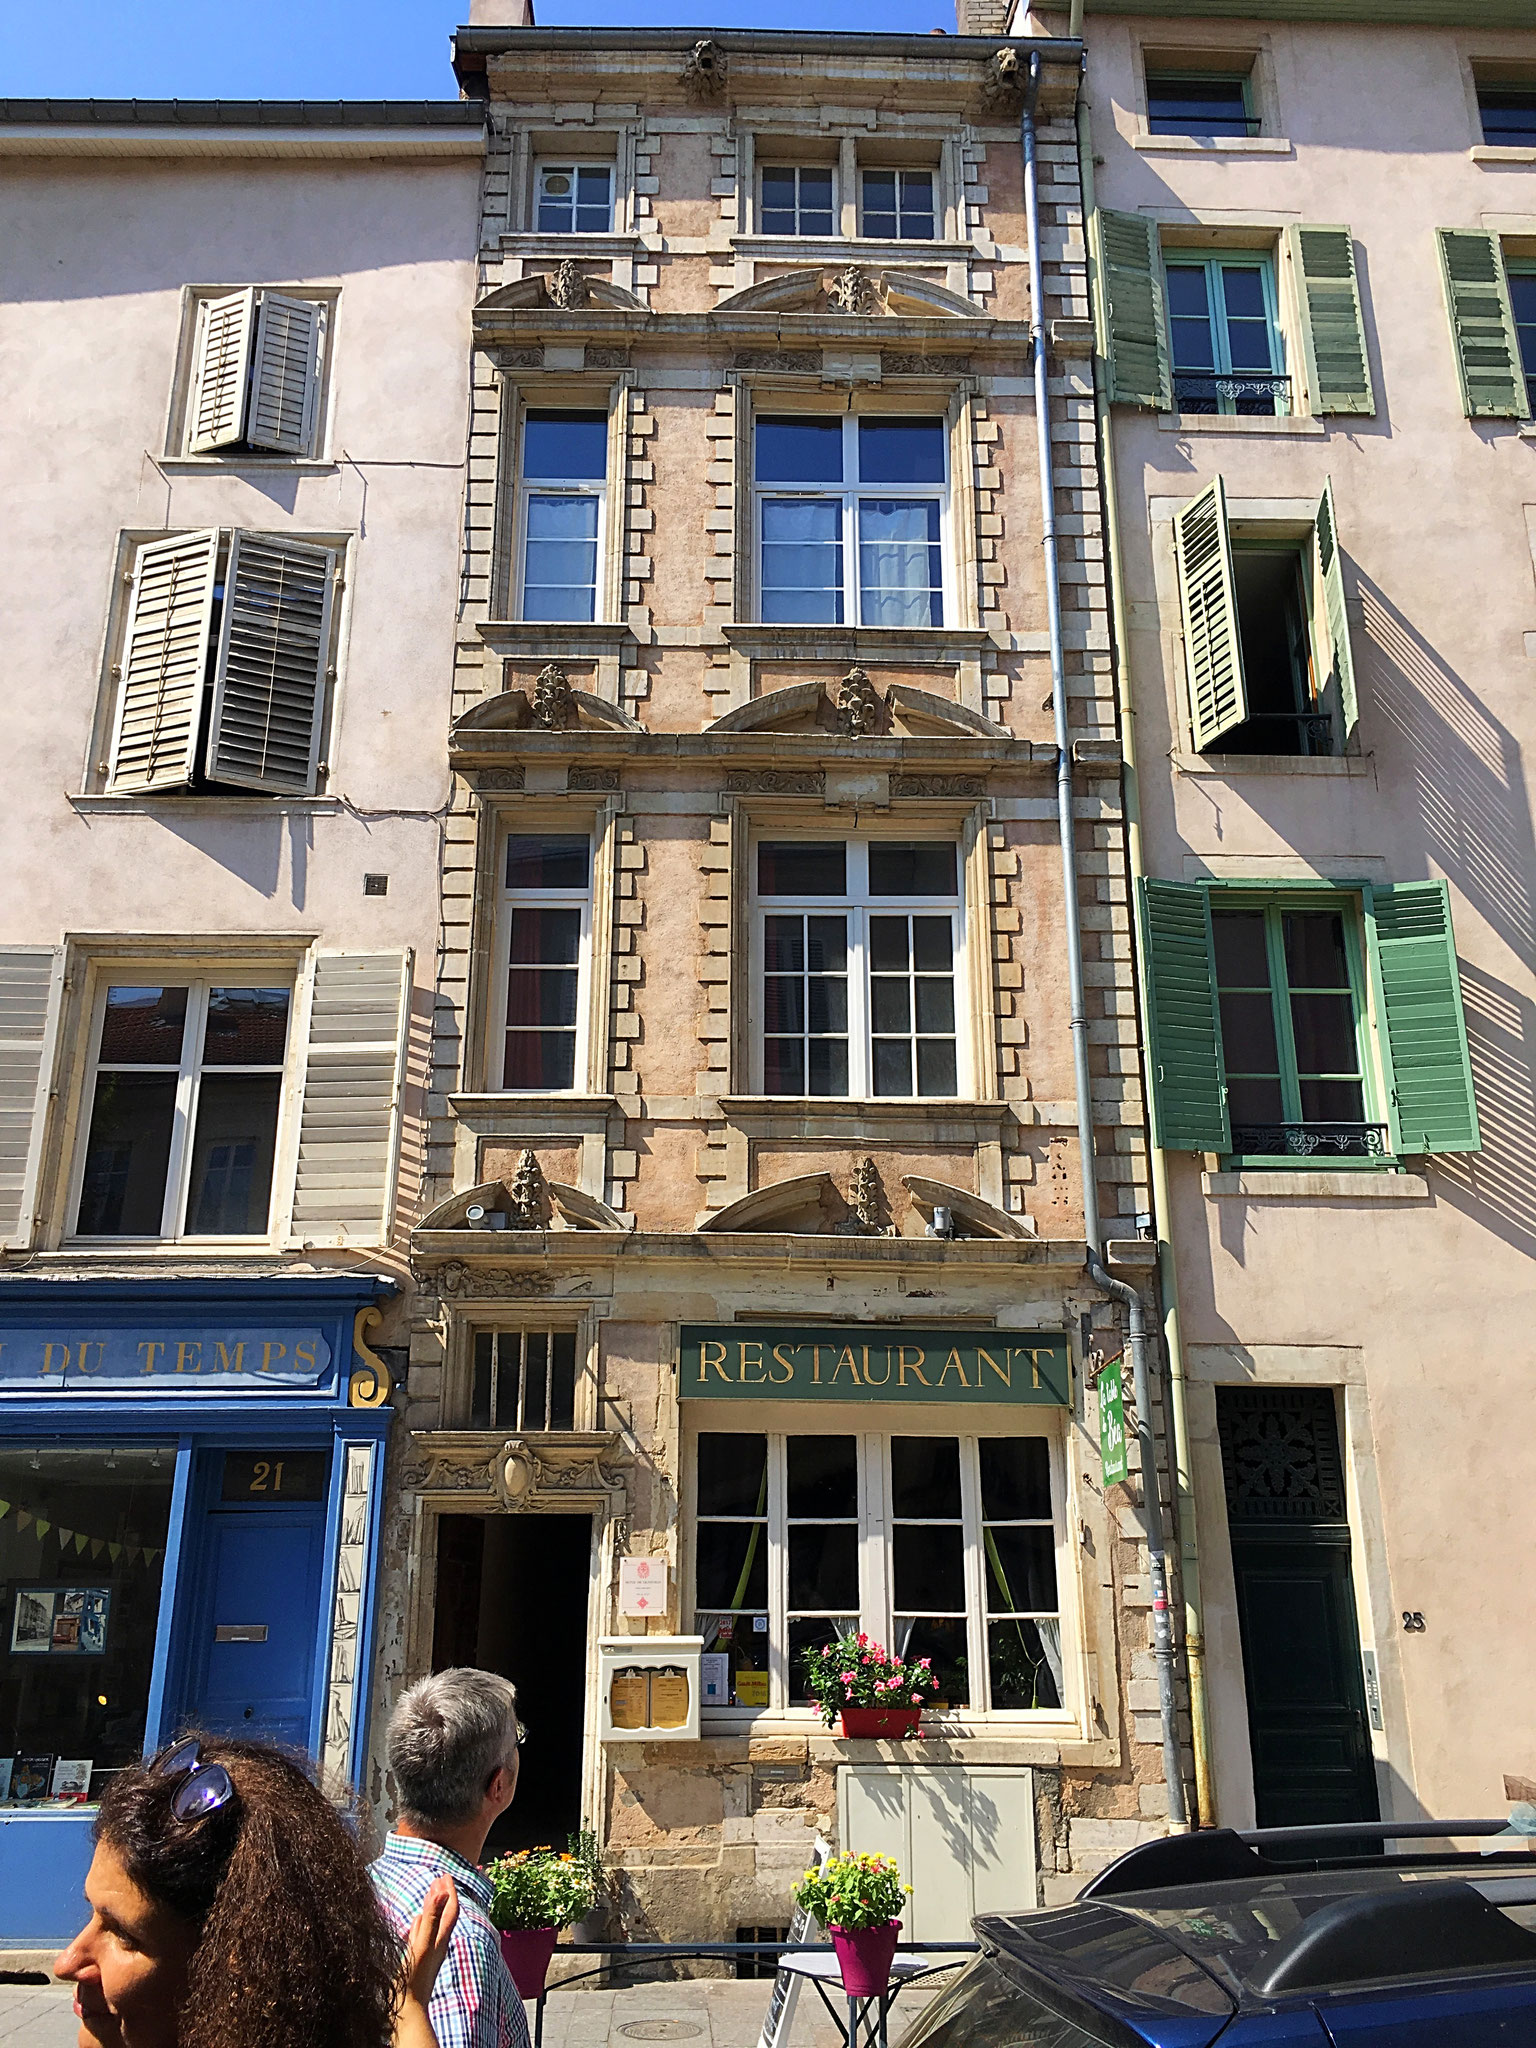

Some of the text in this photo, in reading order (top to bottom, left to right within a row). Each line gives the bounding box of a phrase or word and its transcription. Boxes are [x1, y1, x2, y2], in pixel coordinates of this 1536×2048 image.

[36, 1342, 107, 1373] DU
[137, 1340, 319, 1373] TEMPS
[696, 1340, 1055, 1389] RESTAURANT
[250, 1462, 285, 1491] 21
[1402, 1611, 1426, 1632] 25
